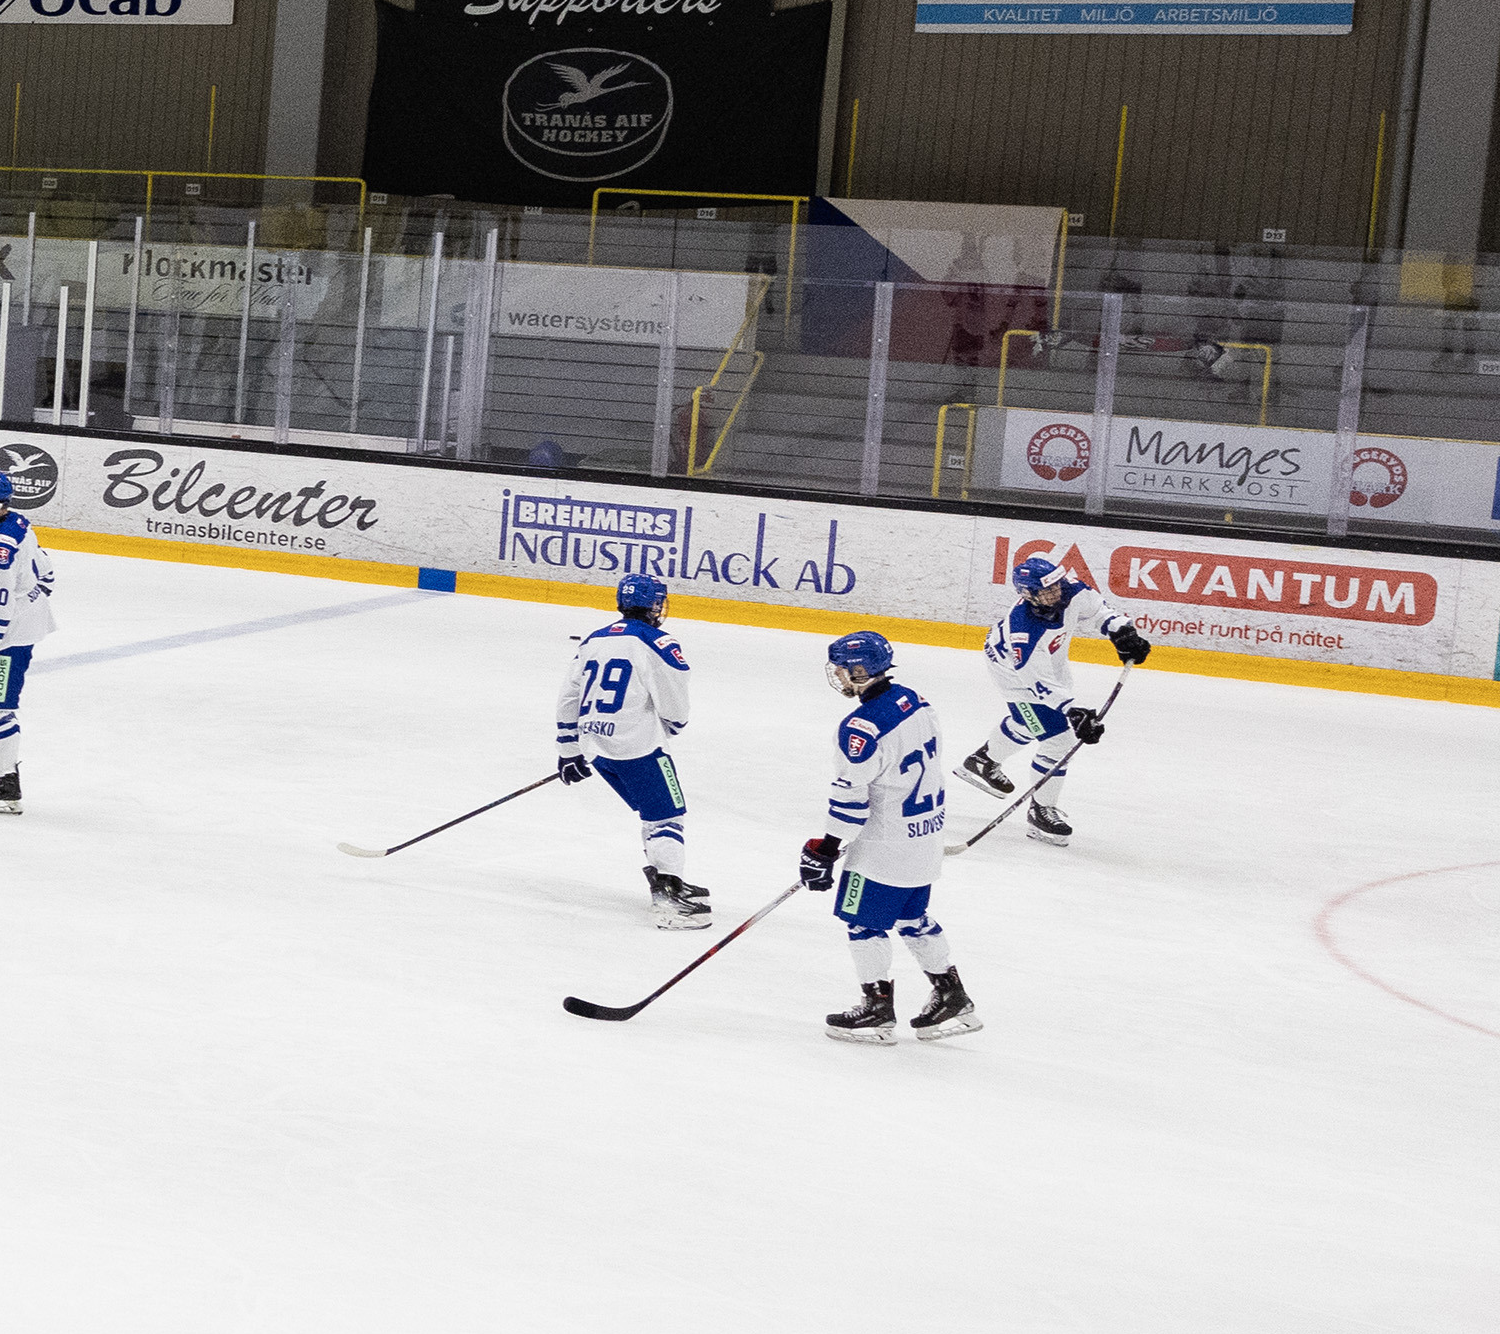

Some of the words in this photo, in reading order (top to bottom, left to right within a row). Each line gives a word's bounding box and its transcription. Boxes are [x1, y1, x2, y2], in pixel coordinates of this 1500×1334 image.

[984, 8, 1062, 22] KVALITET
[1080, 5, 1134, 22] MILJÖ
[1154, 6, 1278, 23] ARBETSMILJÖ
[522, 110, 607, 128] TRANÅS
[614, 113, 653, 127] AIF
[541, 128, 629, 144] HOCKEY
[1125, 426, 1302, 486] Manges
[102, 448, 380, 533] Bilcenter
[1123, 470, 1212, 493] CHARK
[1239, 479, 1298, 500] OST
[146, 516, 326, 551] tranasbilcenter.se
[518, 498, 673, 538] BREHMERS
[1128, 556, 1416, 614] KVANTUM
[1135, 614, 1205, 638] dygnet
[1210, 623, 1250, 640] runt
[1256, 623, 1286, 646] på
[1290, 628, 1344, 650] nätet
